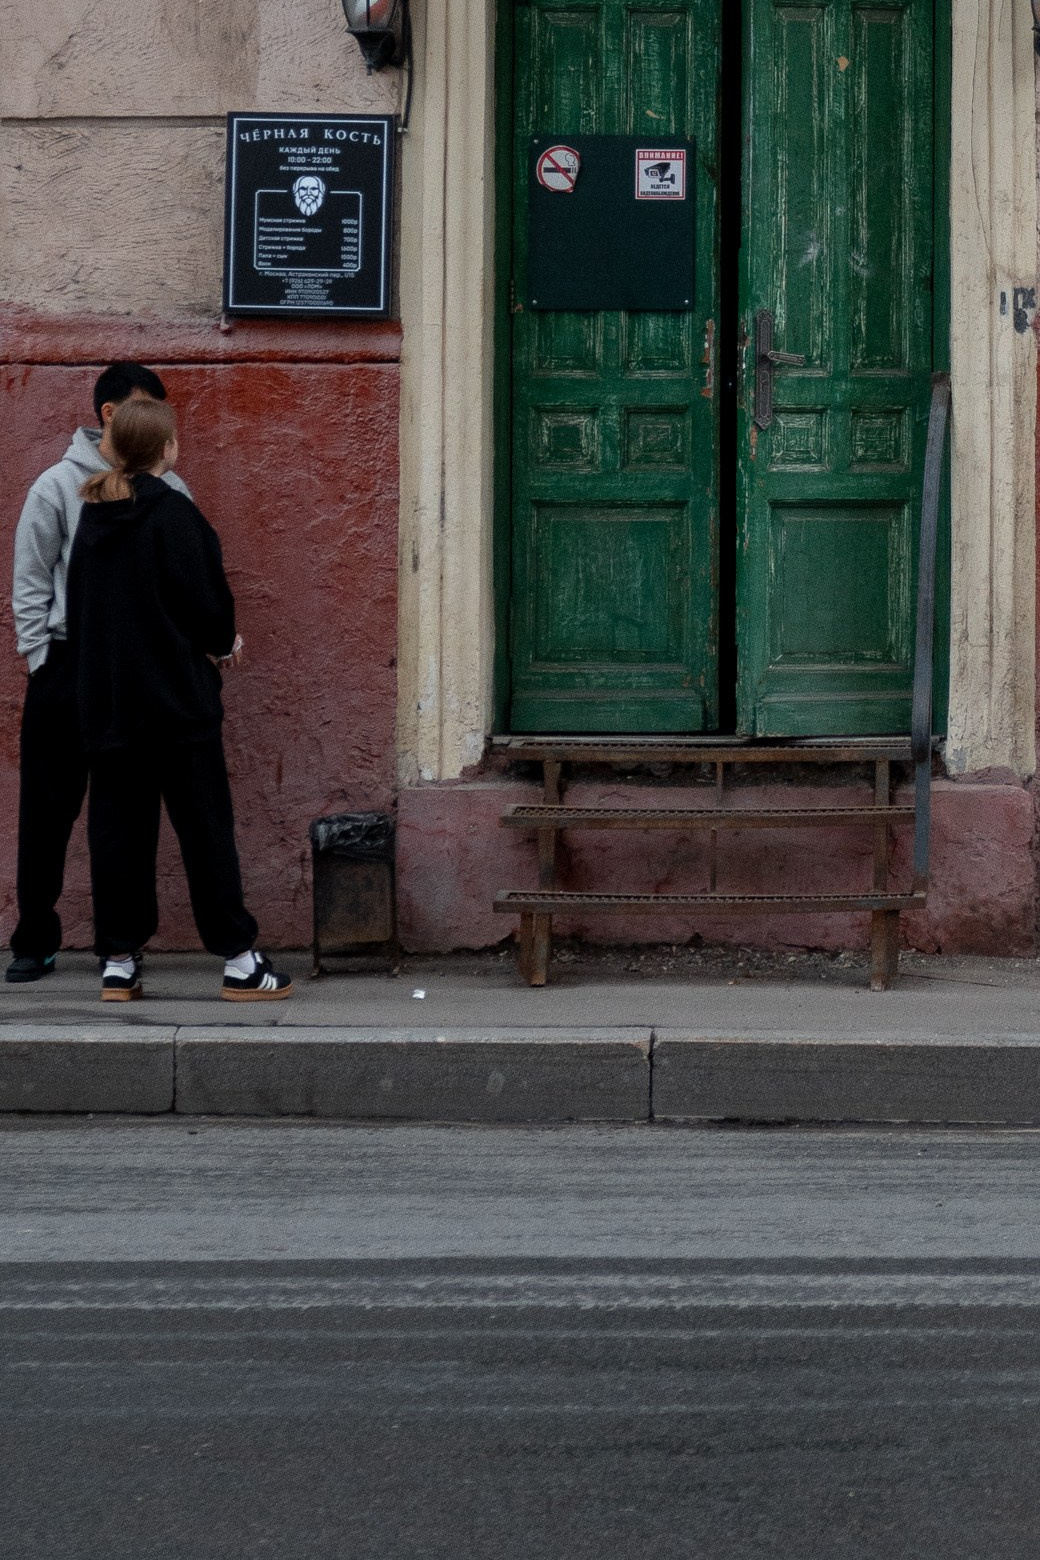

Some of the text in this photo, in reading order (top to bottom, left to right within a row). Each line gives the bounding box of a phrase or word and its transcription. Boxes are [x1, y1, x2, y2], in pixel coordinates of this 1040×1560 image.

[240, 129, 381, 145] ЧЁРНАЯ КОСТЬ
[279, 146, 317, 154] КАЖДЫЙ
